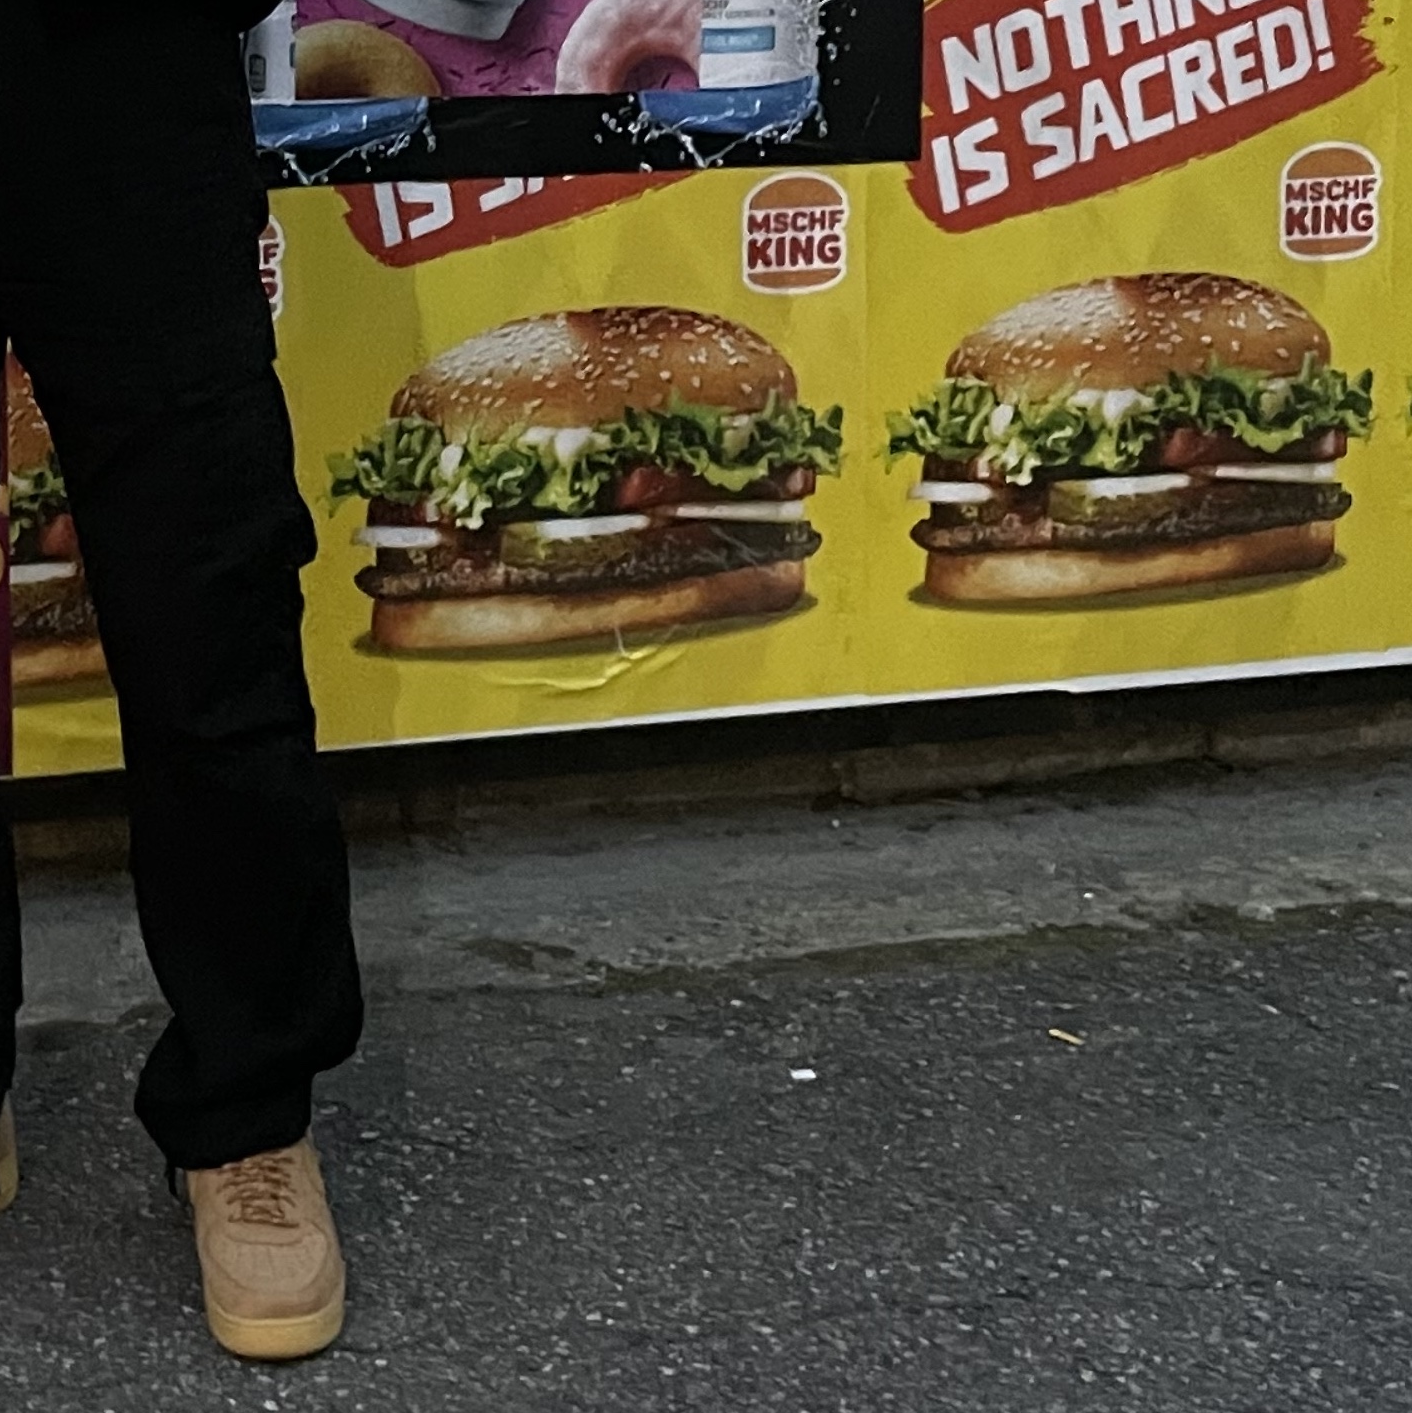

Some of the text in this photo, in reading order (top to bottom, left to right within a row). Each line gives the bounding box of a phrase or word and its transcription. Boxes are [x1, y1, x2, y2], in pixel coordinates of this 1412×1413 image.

[931, 118, 1010, 214] IS
[1286, 178, 1378, 204] MSCHF
[748, 209, 845, 235] MSCHF
[1285, 203, 1374, 236] KING
[748, 234, 842, 269] KING
